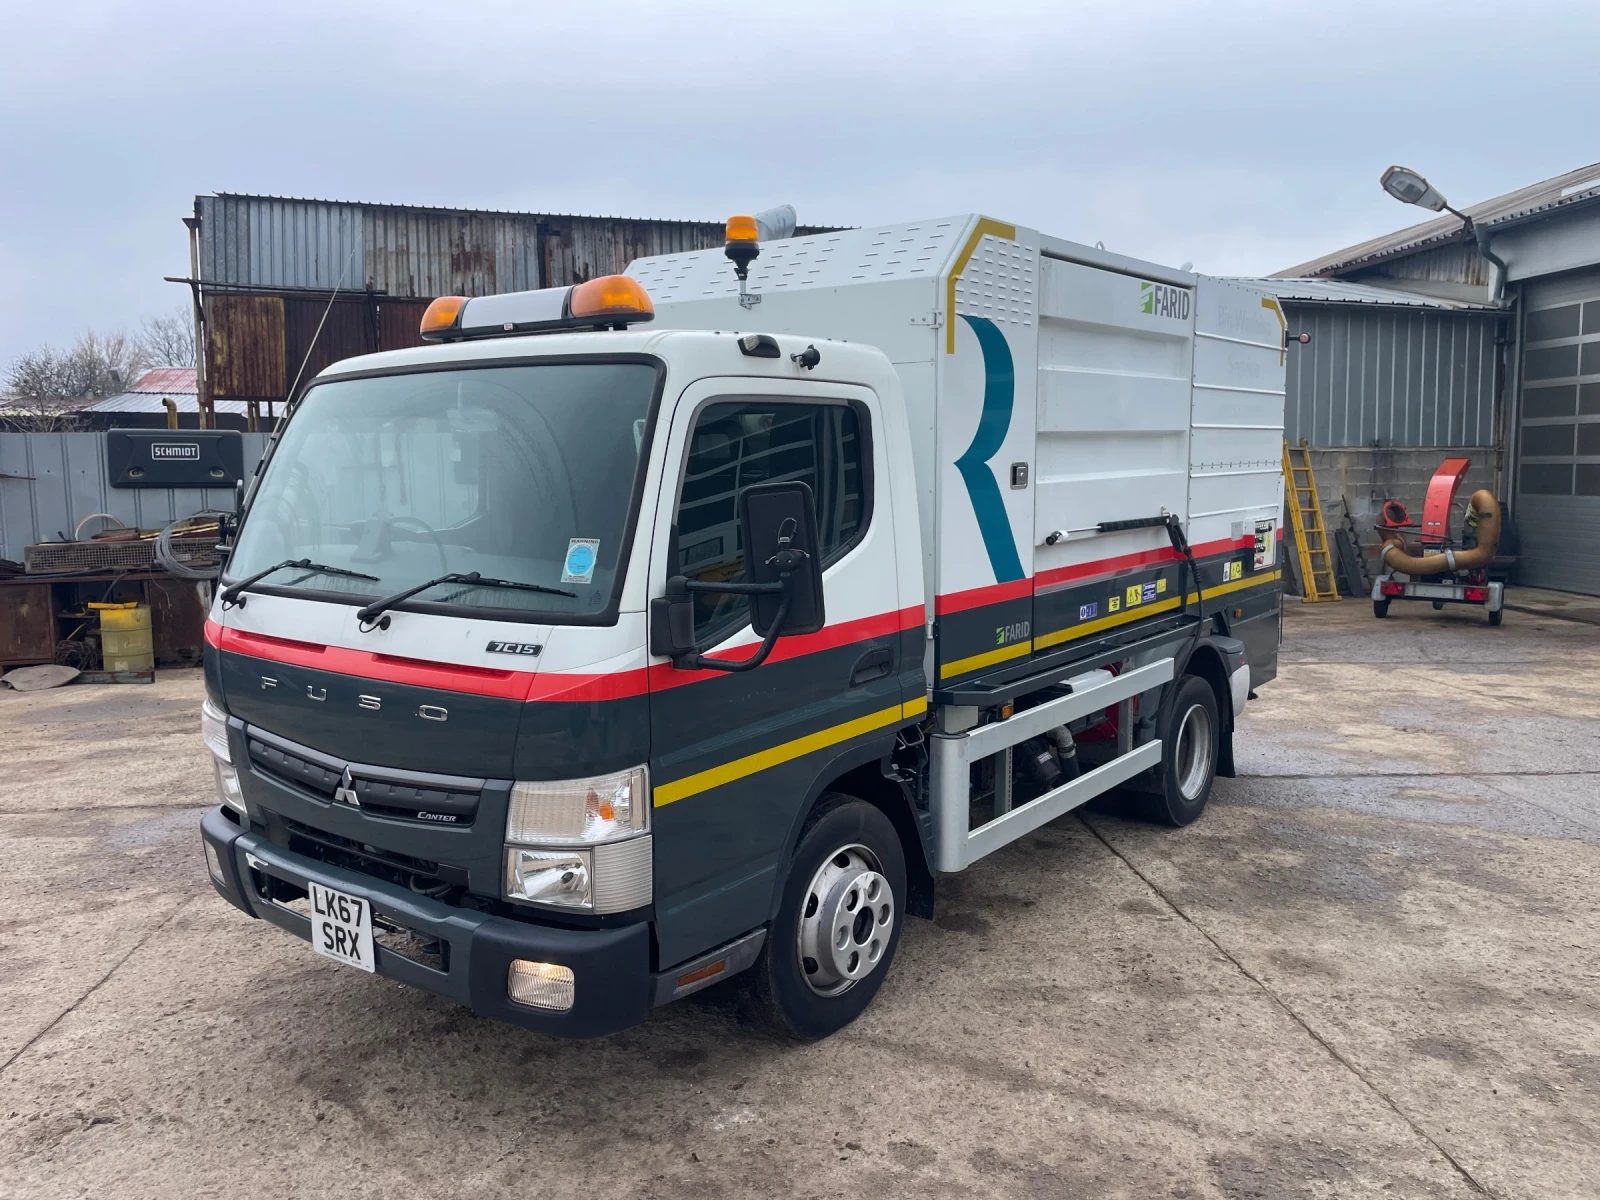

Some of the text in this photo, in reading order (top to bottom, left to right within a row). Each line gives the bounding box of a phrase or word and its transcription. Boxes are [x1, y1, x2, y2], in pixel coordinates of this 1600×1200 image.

[1154, 285, 1190, 320] FARID
[155, 447, 196, 456] SCHMIDT
[494, 642, 536, 654] 7C15
[1005, 621, 1030, 642] FARID
[261, 676, 448, 722] FUSO
[313, 886, 363, 927] LK67
[322, 922, 361, 960] SRX
